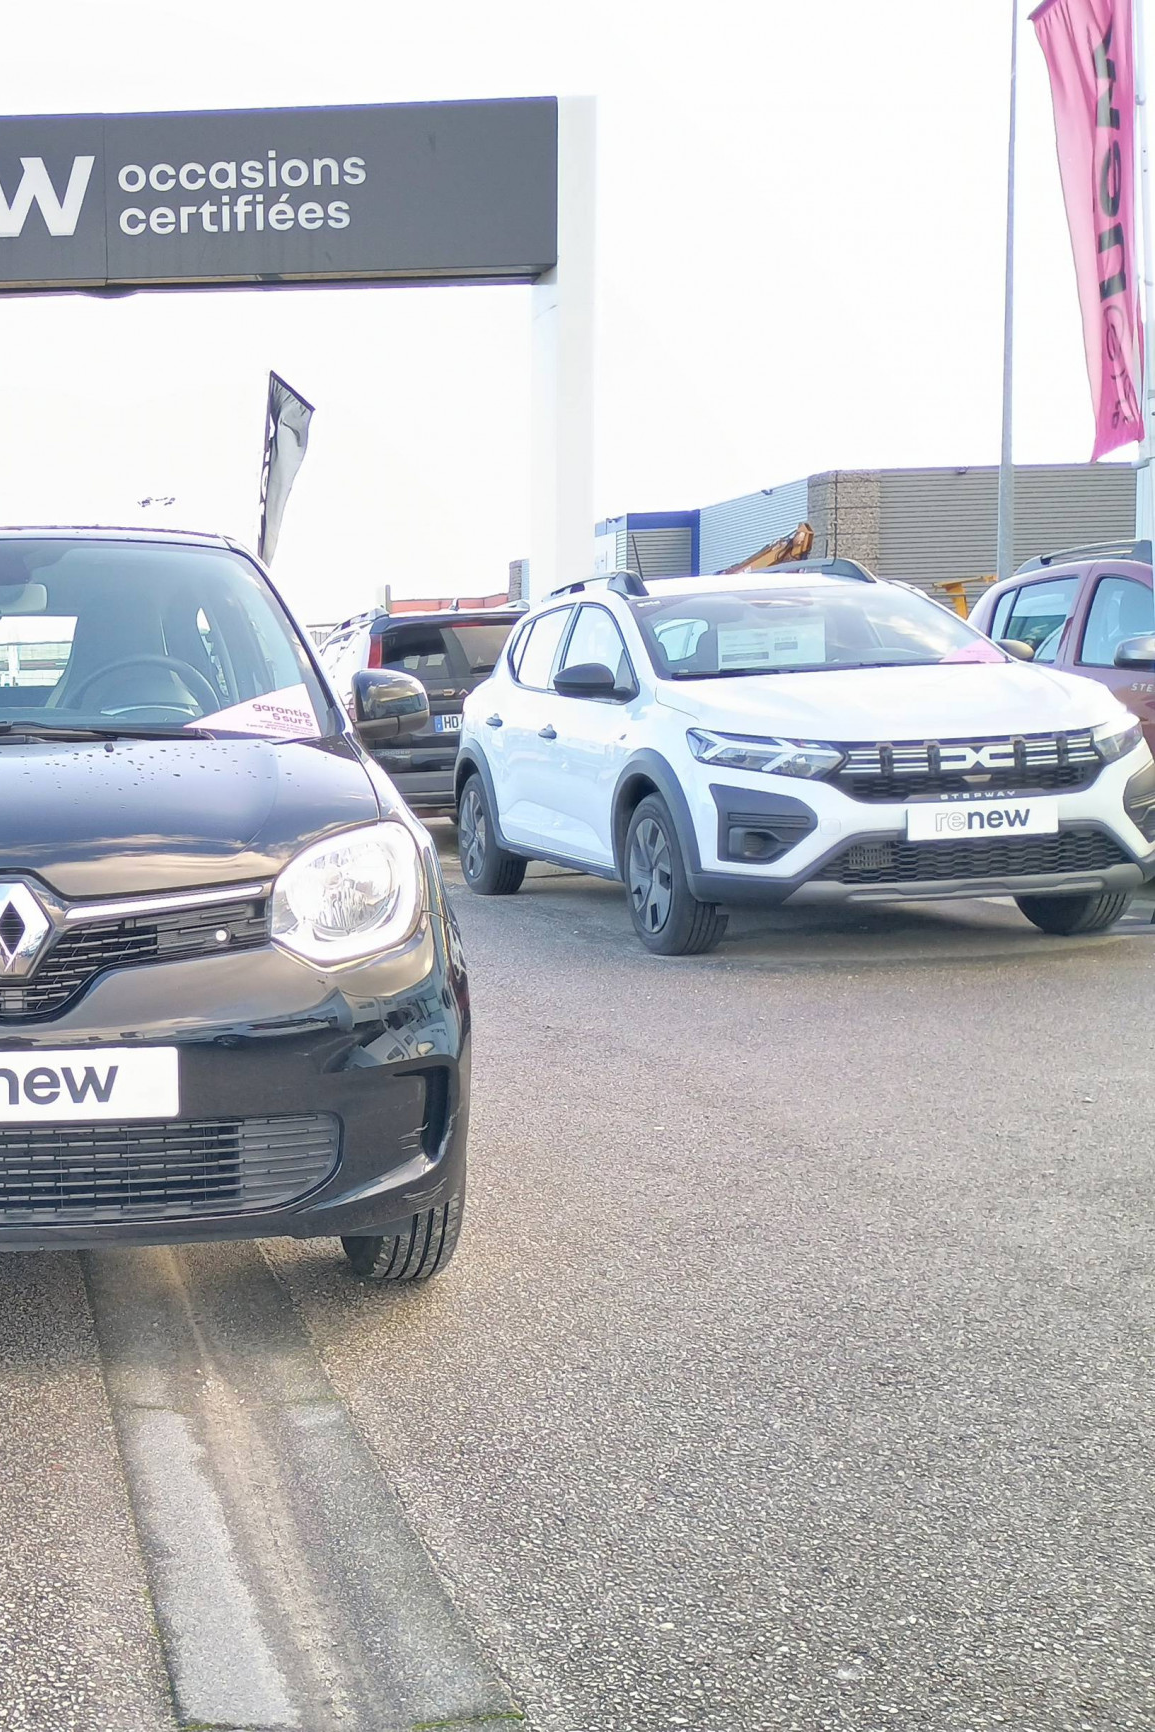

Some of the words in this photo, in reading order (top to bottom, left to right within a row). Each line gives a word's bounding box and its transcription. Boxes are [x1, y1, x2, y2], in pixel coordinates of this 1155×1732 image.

[117, 149, 366, 193] occasions
[119, 193, 351, 236] certifiées
[252, 703, 311, 719] garantie
[272, 712, 281, 721] 5
[282, 715, 303, 725] sur
[305, 719, 314, 727] 5
[940, 790, 1016, 800] STEPWAY
[935, 808, 1030, 832] renew
